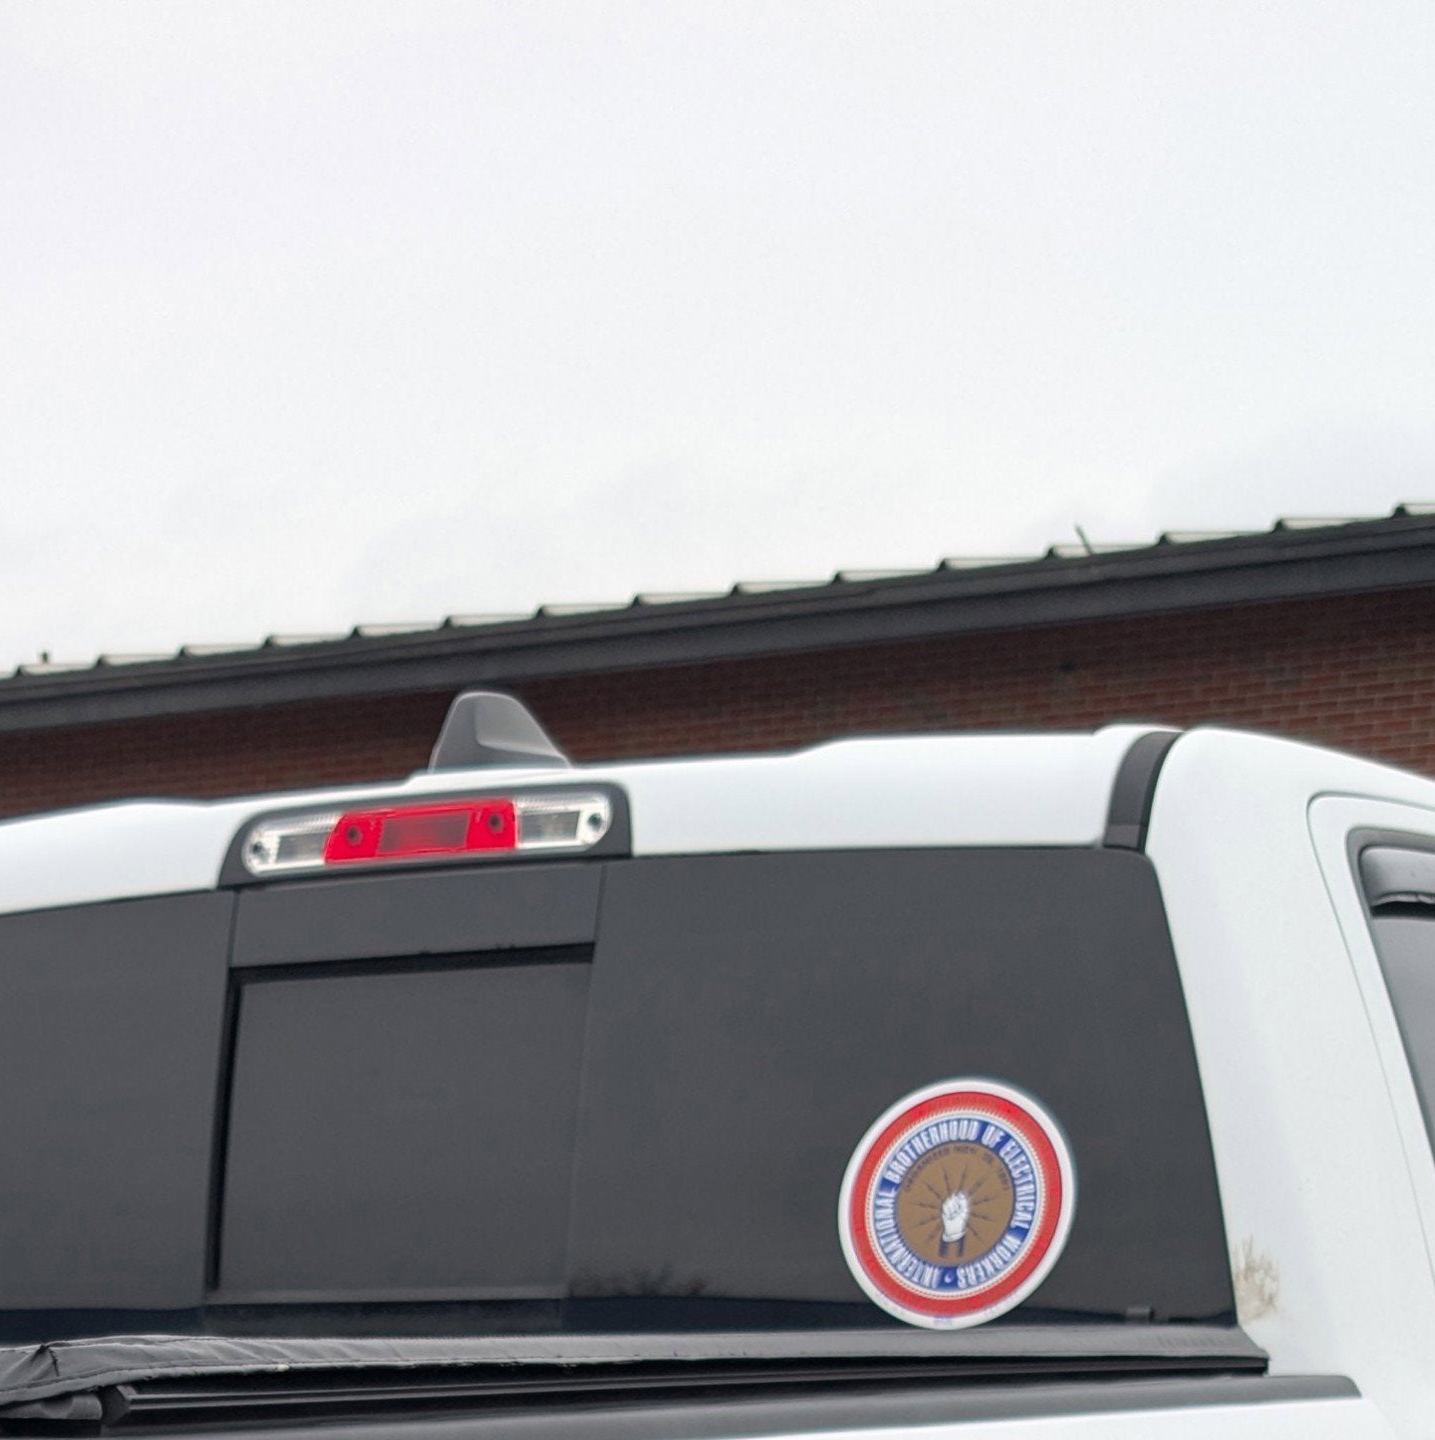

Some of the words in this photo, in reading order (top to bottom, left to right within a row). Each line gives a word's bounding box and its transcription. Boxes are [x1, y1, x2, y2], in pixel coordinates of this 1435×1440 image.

[887, 1120, 979, 1184] BROTHERHOOD
[982, 1123, 1007, 1148] OF
[1000, 1133, 1035, 1230] ELECTRICAL
[875, 1191, 939, 1289] INTERNATIONAL
[957, 1235, 1022, 1288] WORKERS
